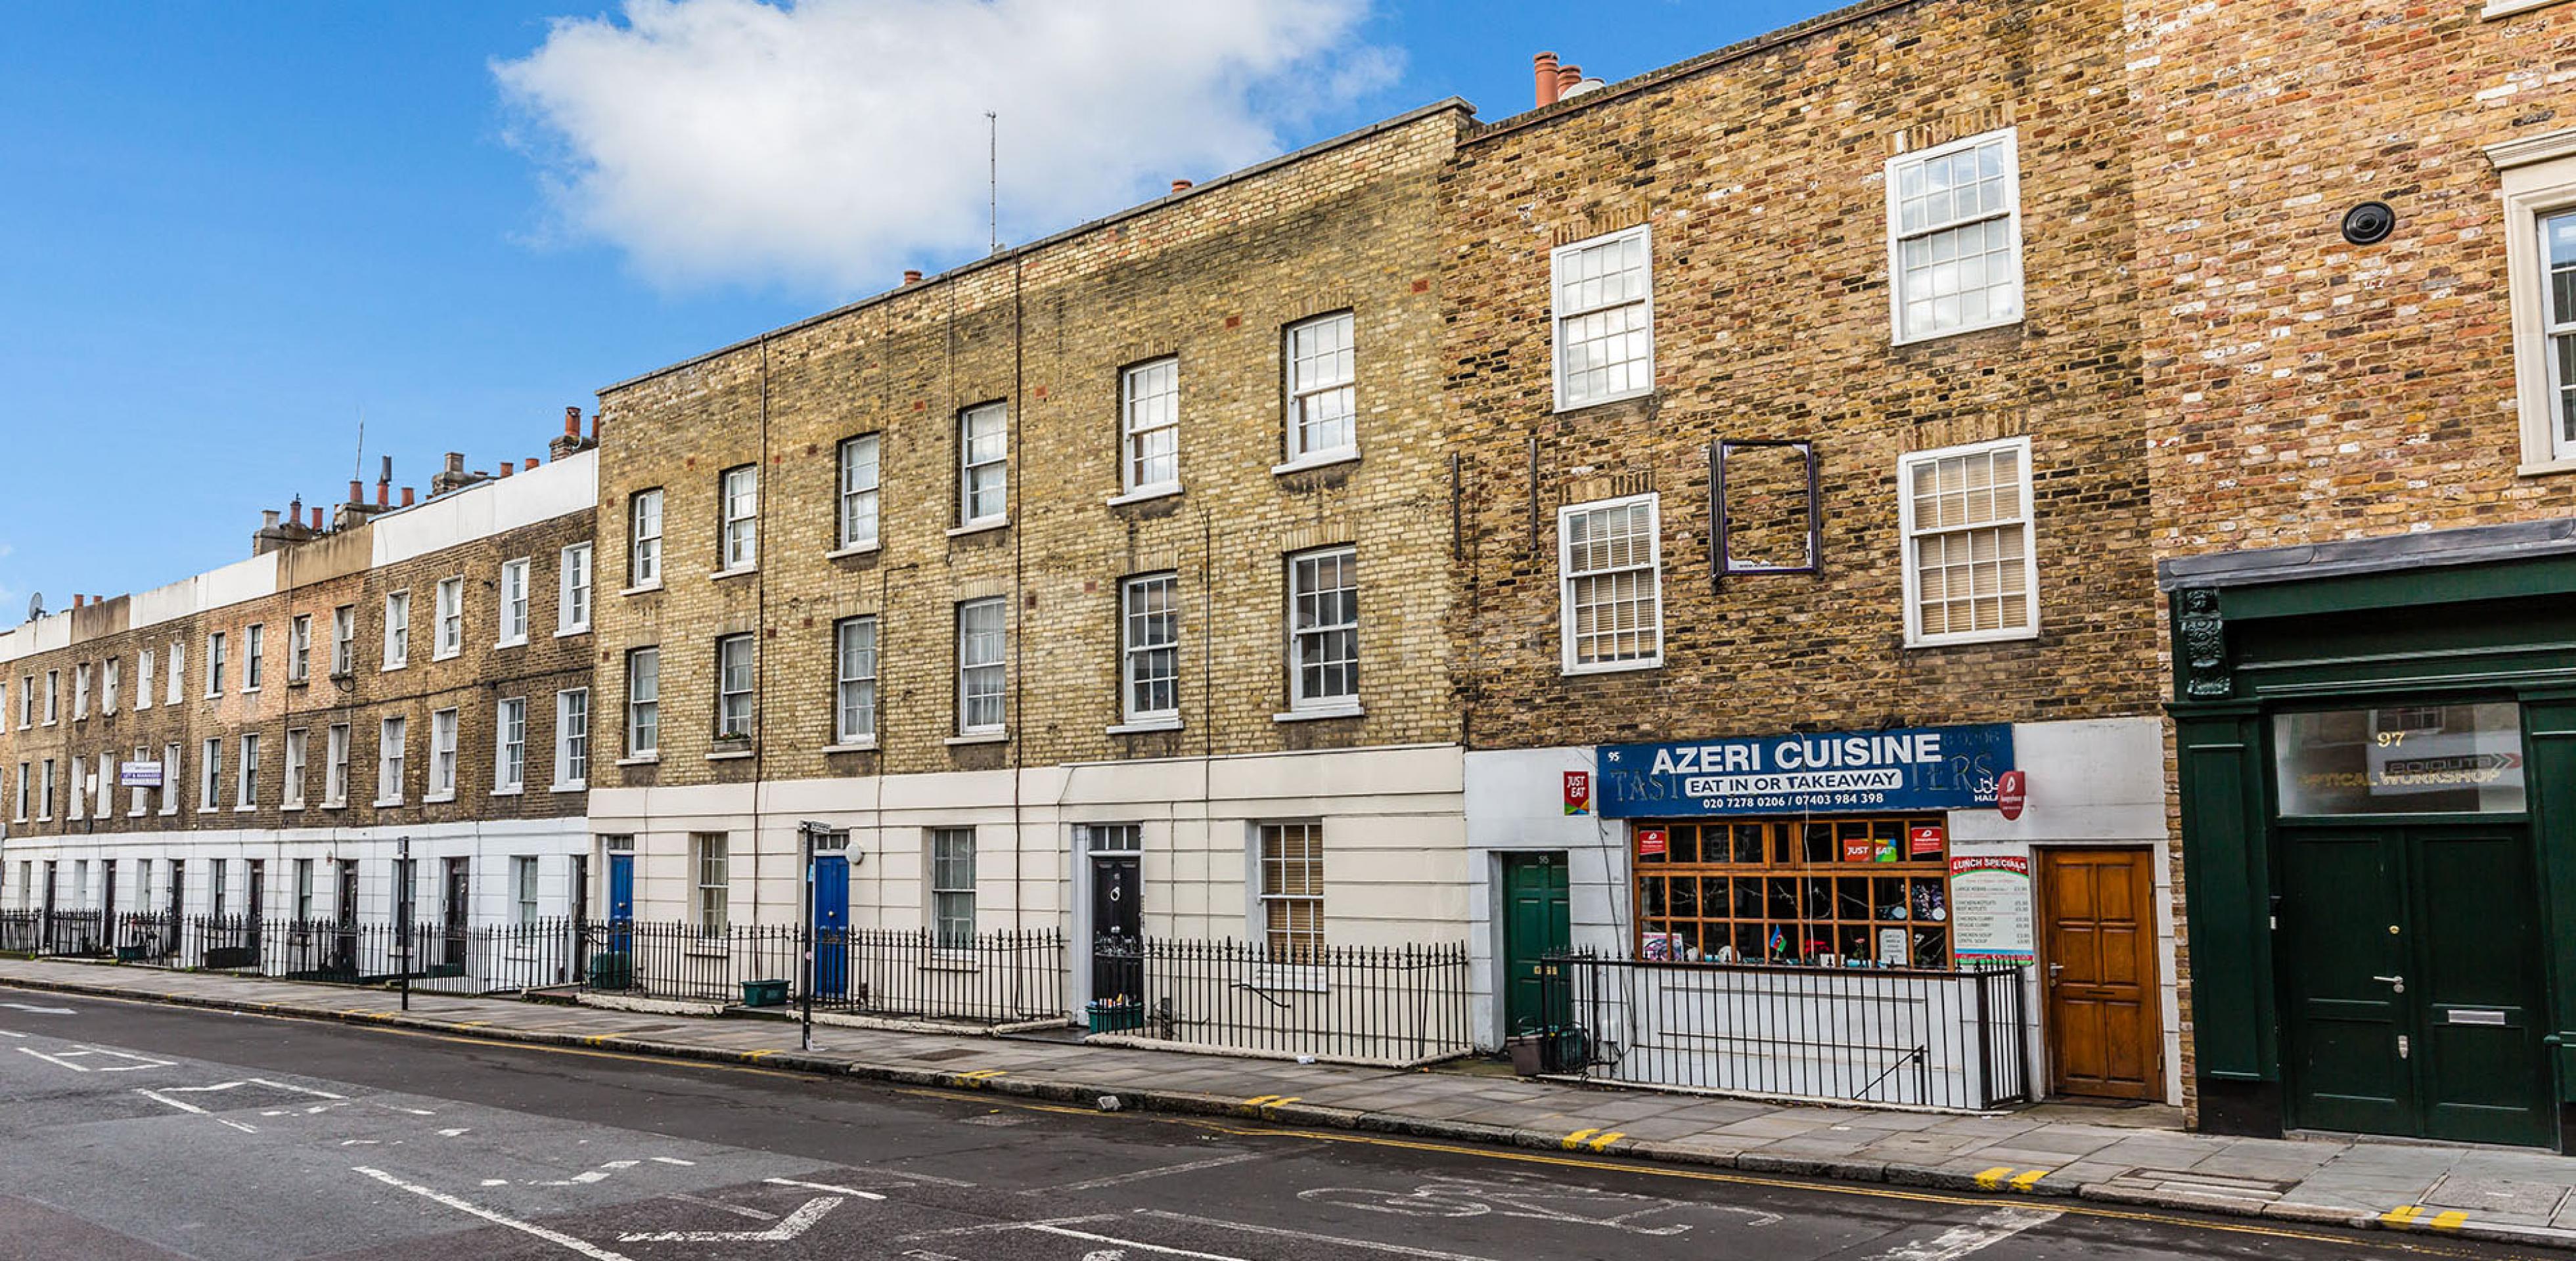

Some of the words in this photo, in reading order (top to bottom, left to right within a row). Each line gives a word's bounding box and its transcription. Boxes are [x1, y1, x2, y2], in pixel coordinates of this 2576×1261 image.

[2377, 732, 2405, 747] 97
[1608, 751, 1620, 762] 95
[1651, 743, 1761, 774] AZERI
[1774, 734, 1943, 770] CUISINE
[1567, 776, 1586, 788] JUST
[1690, 780, 1724, 793] EAT
[1729, 778, 1749, 792] IN
[1754, 777, 1782, 791] OR
[1786, 772, 1897, 789] TAKEAWAY
[2380, 769, 2501, 785] WORKSHOP
[1570, 787, 1586, 797] EAT
[1703, 799, 1723, 808] 020
[1727, 797, 1754, 808] 7278
[1757, 796, 1785, 807] 0206
[1795, 795, 1831, 805] 07403
[1835, 793, 1857, 804] 984
[1861, 792, 1884, 803] 398
[1847, 846, 1869, 856] JUST
[1953, 858, 1983, 870] LUNCH
[1984, 858, 2027, 870] SPECIALS
